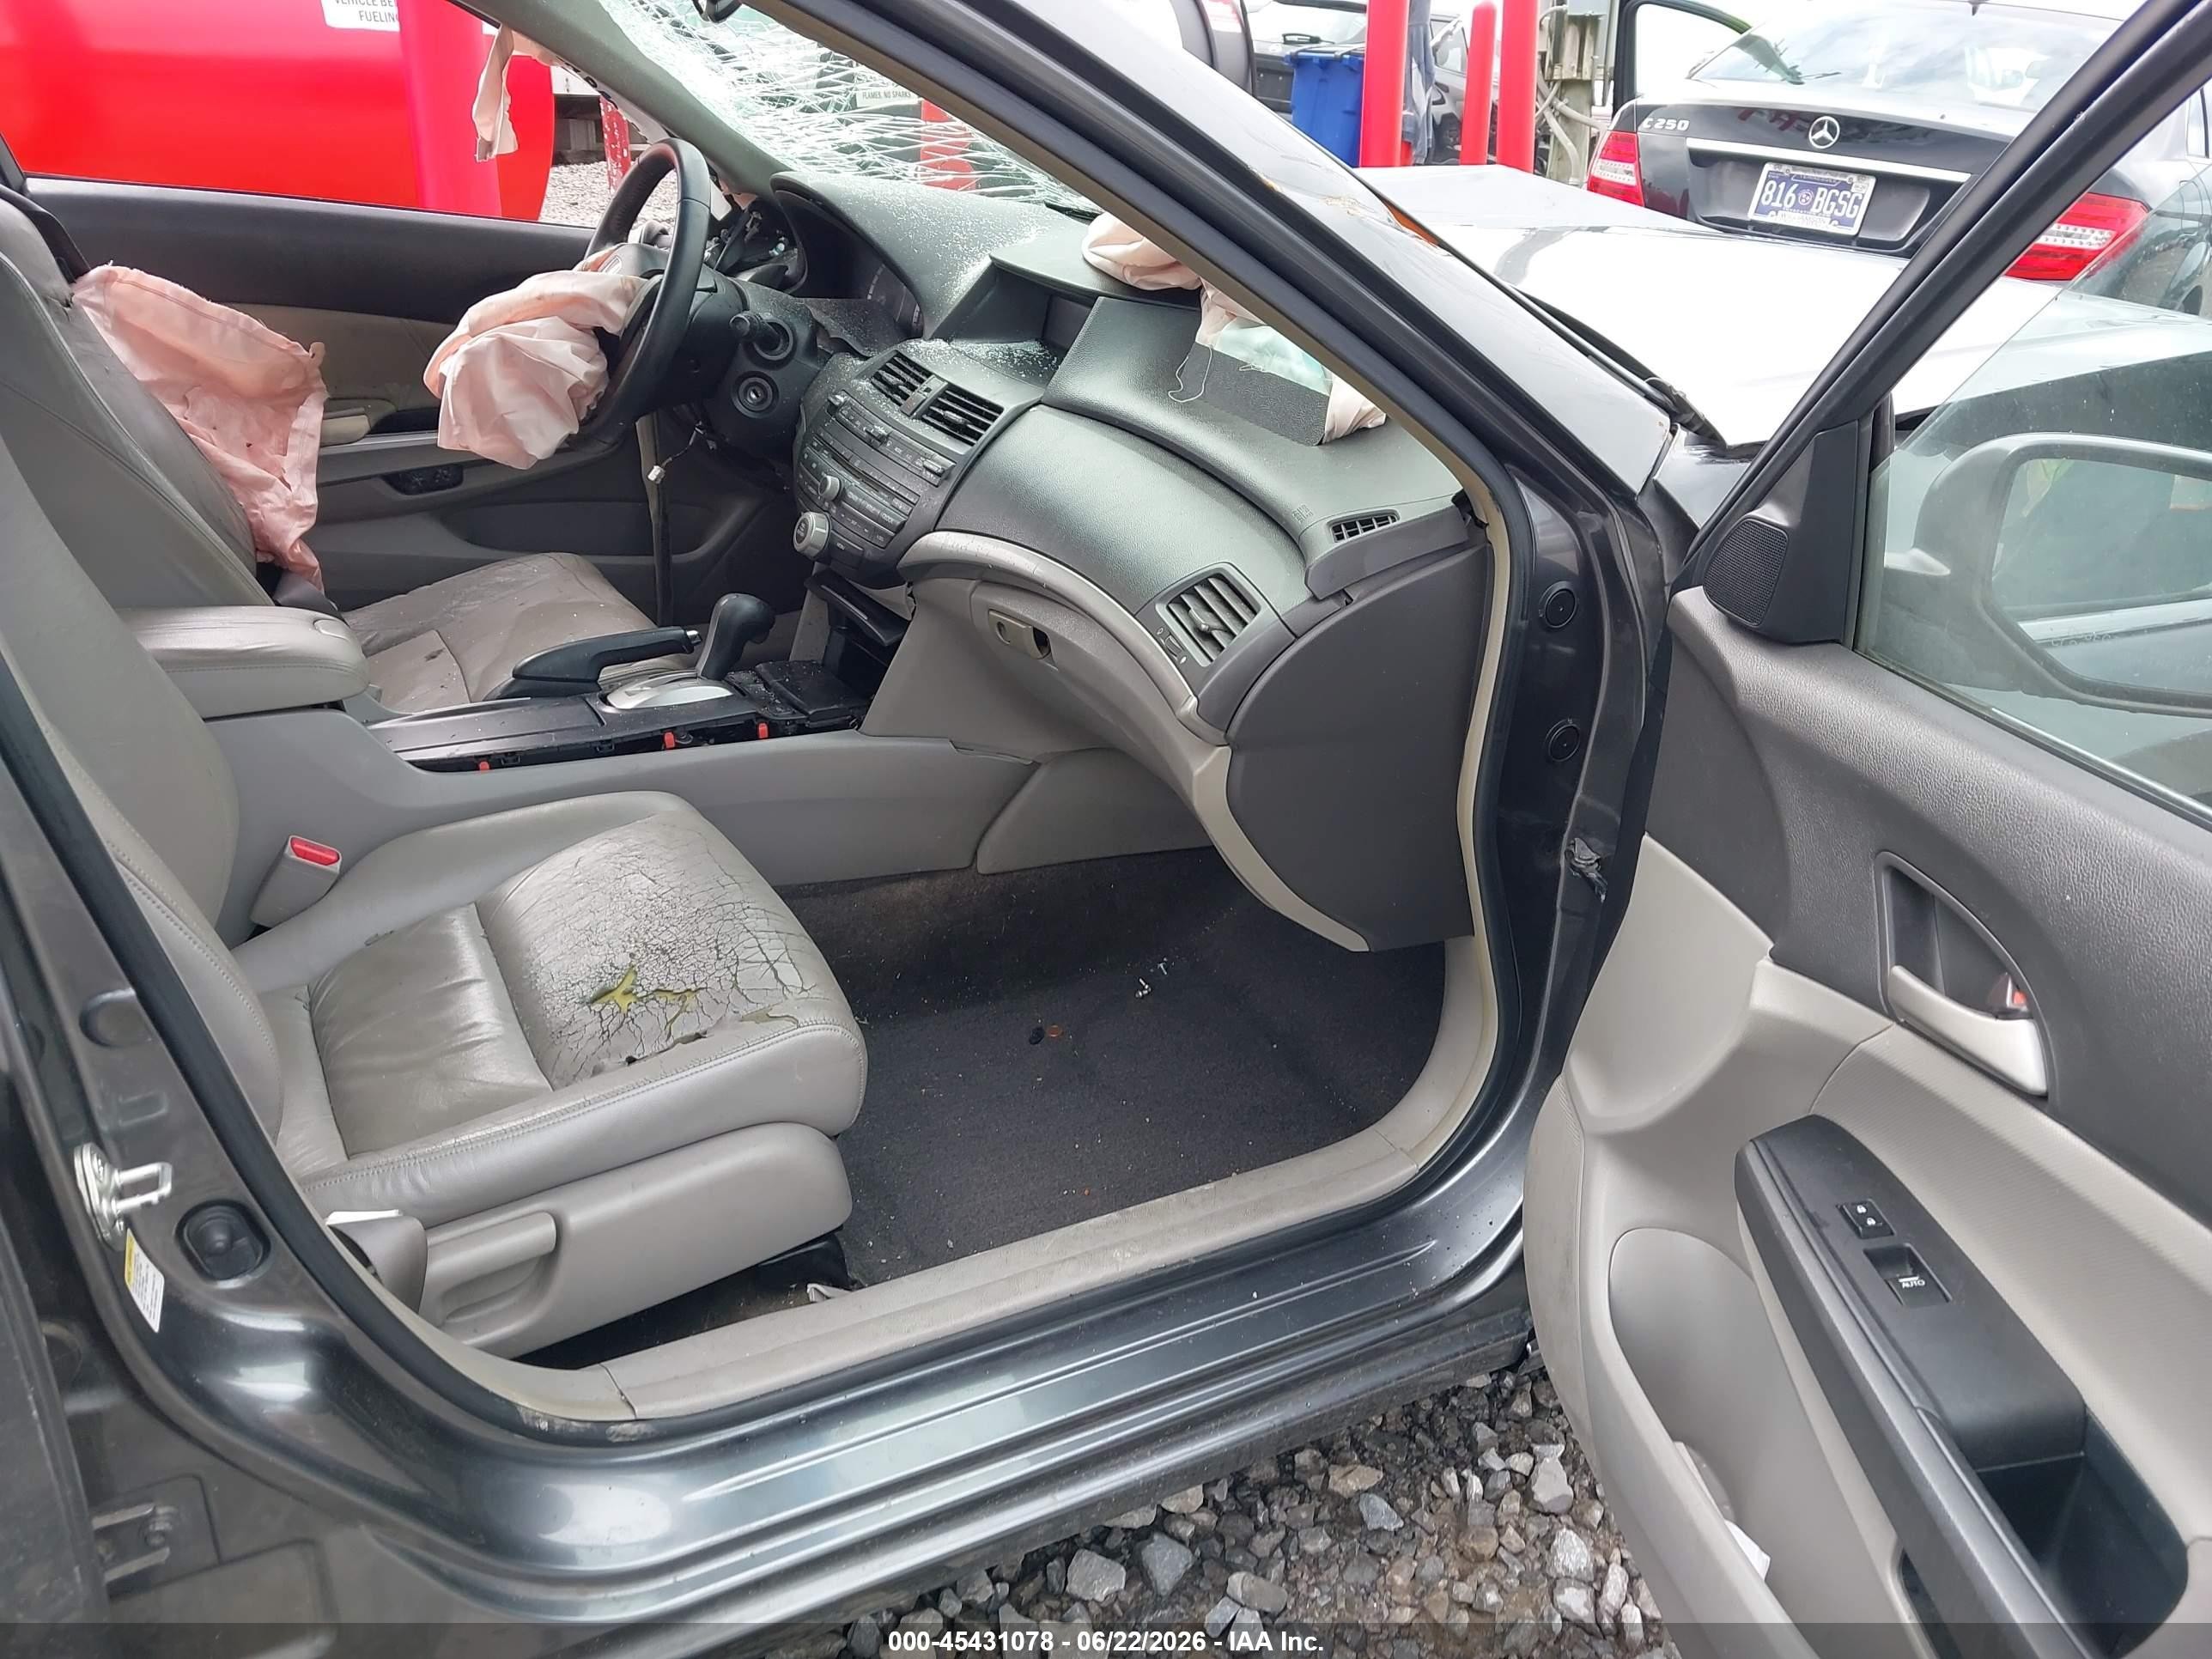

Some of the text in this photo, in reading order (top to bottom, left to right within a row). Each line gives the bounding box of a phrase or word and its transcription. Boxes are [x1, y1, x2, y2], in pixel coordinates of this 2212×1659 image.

[358, 10, 398, 22] FUELIN
[1643, 118, 1690, 131] C 250
[1760, 180, 1863, 218] 816 BGSG
[1902, 1279, 1925, 1289] AUTO
